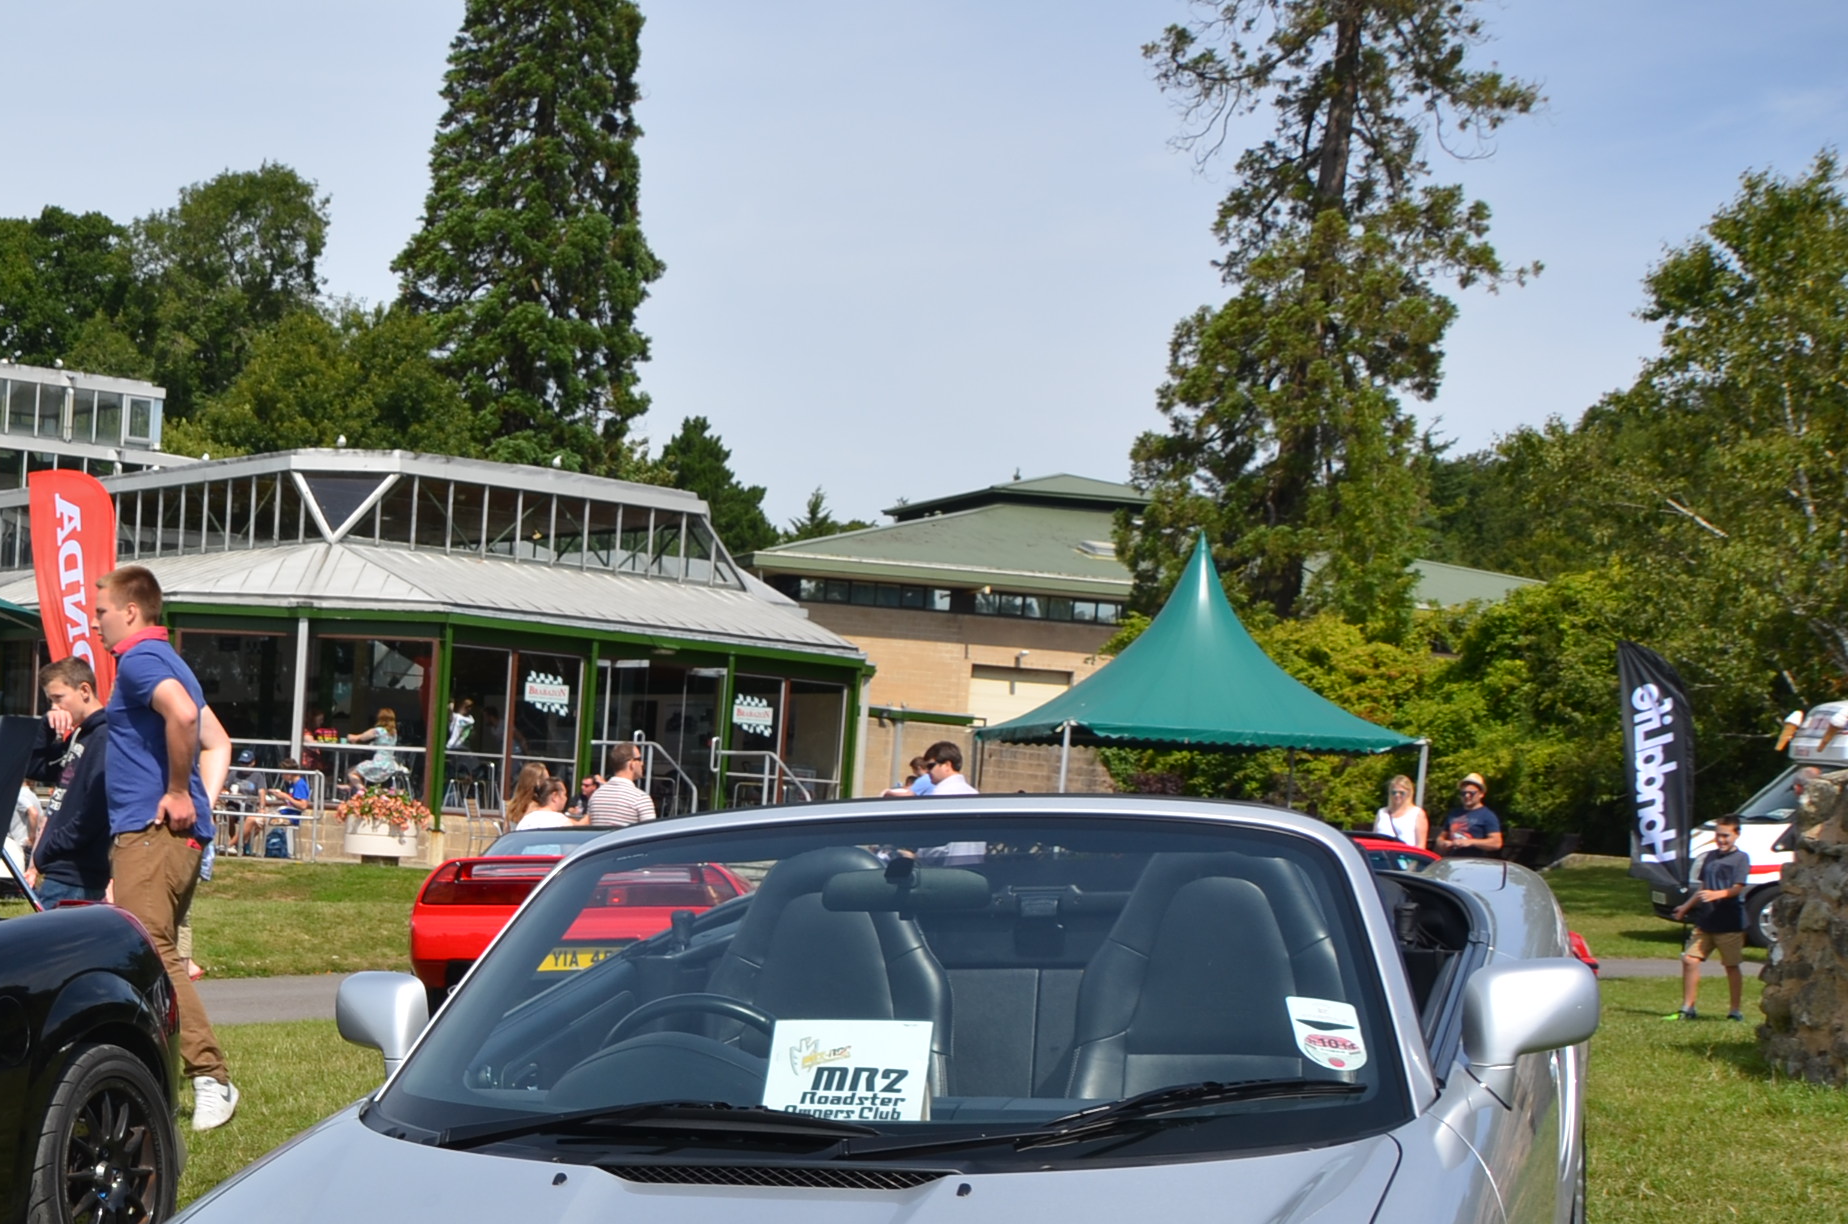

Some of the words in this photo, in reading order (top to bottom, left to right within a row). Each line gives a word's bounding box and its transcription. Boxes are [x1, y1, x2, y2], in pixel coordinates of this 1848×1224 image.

[553, 951, 579, 967] YIA
[811, 1067, 909, 1093] MR2
[800, 1092, 906, 1106] Roadster
[858, 1107, 901, 1120] Club
